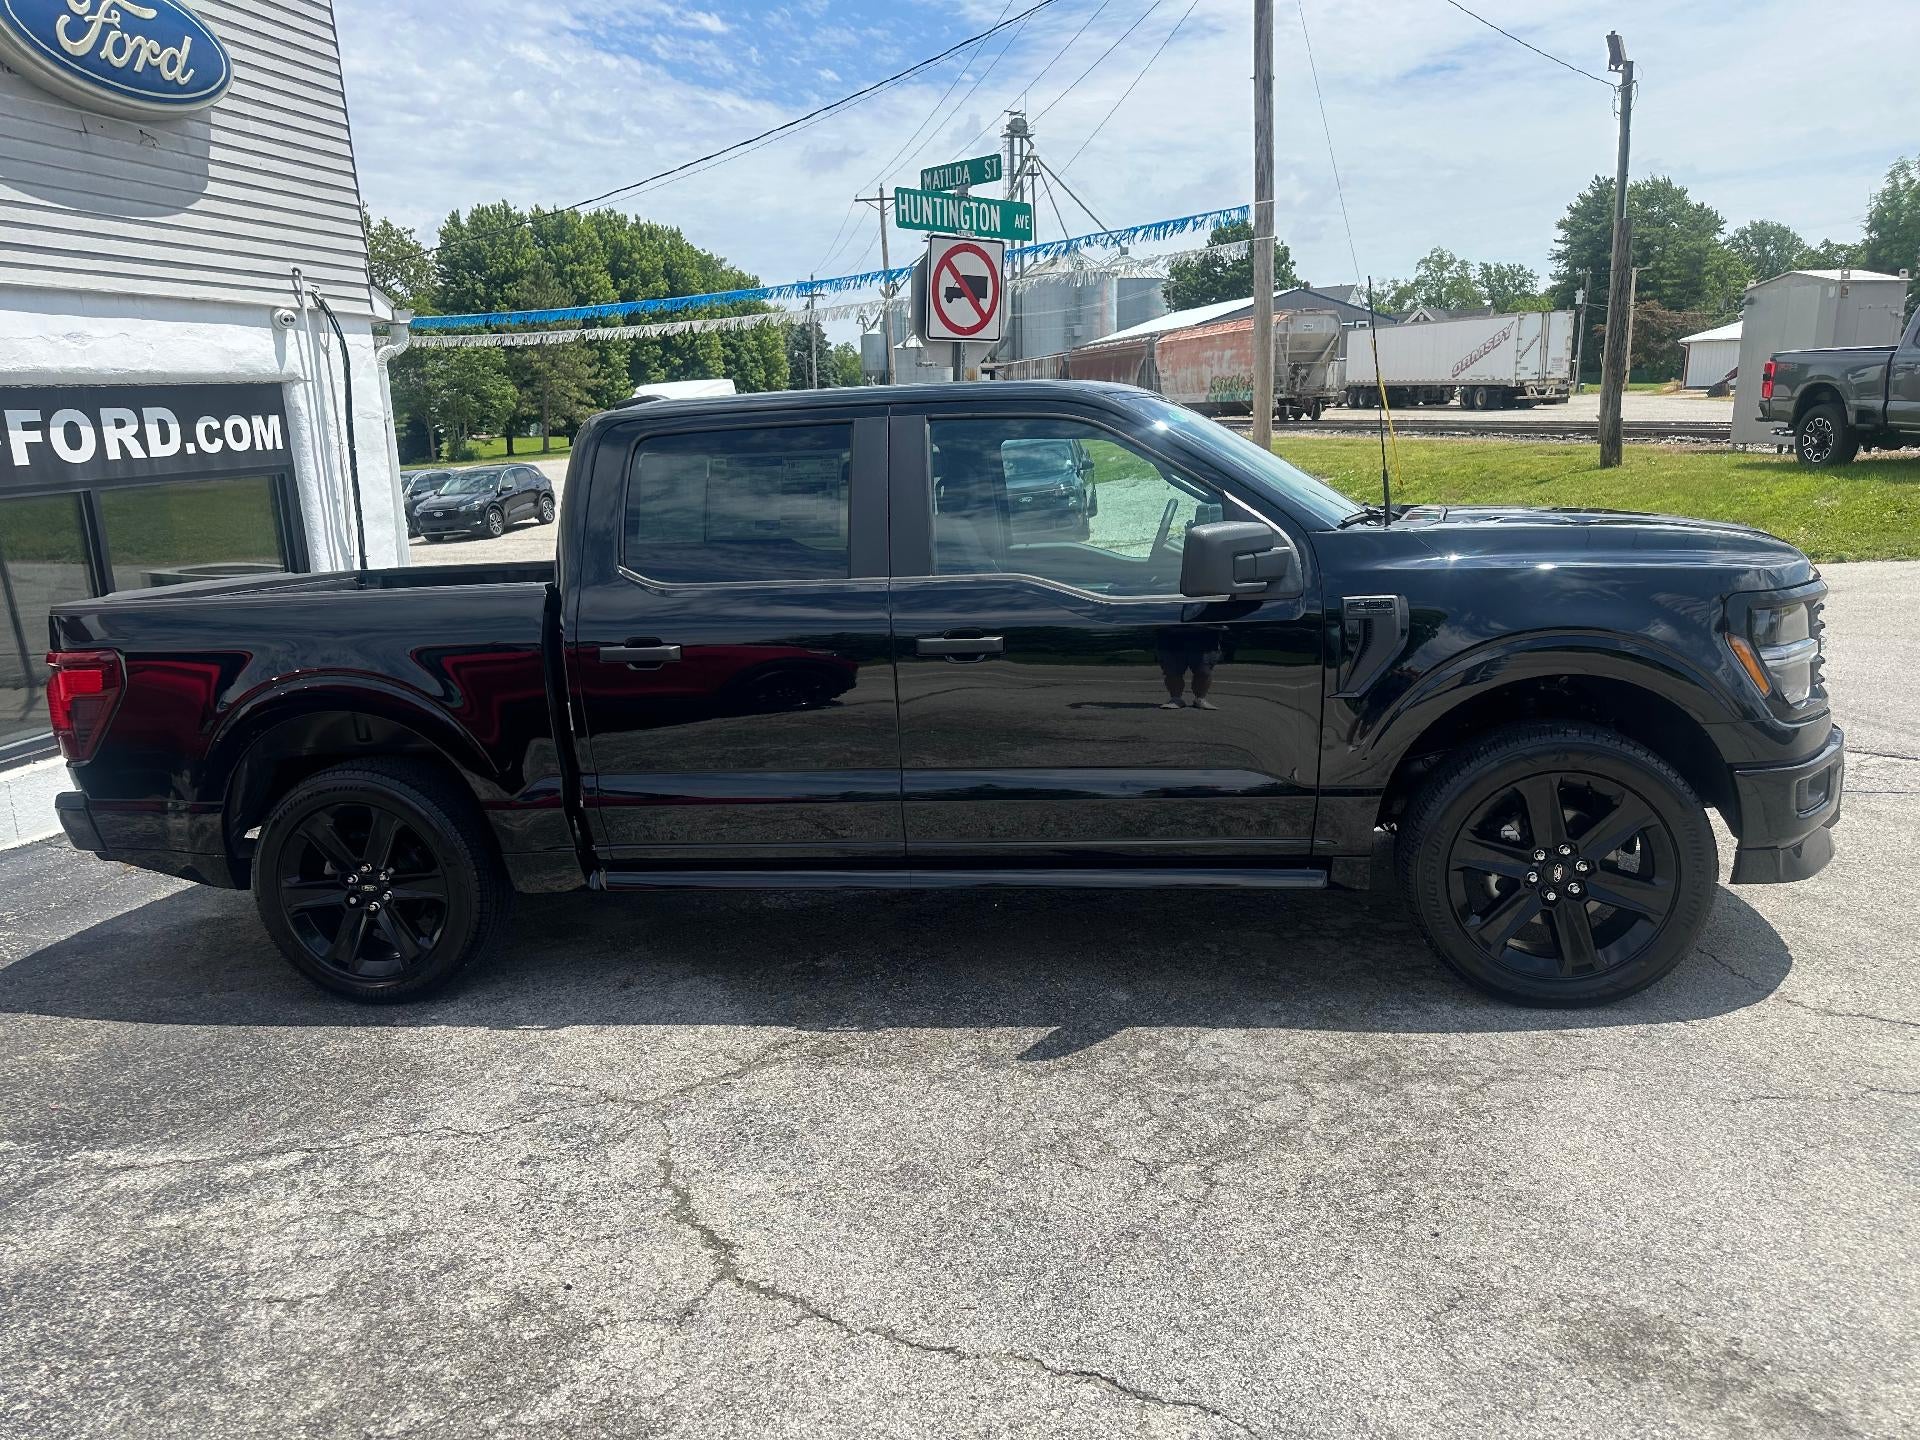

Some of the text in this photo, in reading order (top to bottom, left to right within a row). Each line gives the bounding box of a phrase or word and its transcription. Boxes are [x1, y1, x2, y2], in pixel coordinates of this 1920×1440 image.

[55, 0, 195, 86] Ford
[923, 158, 998, 191] MATILDA ST
[898, 193, 1030, 233] HUNTINGTON AVE
[1451, 320, 1515, 378] ORMSBY
[0, 407, 284, 467] FORD.COM
